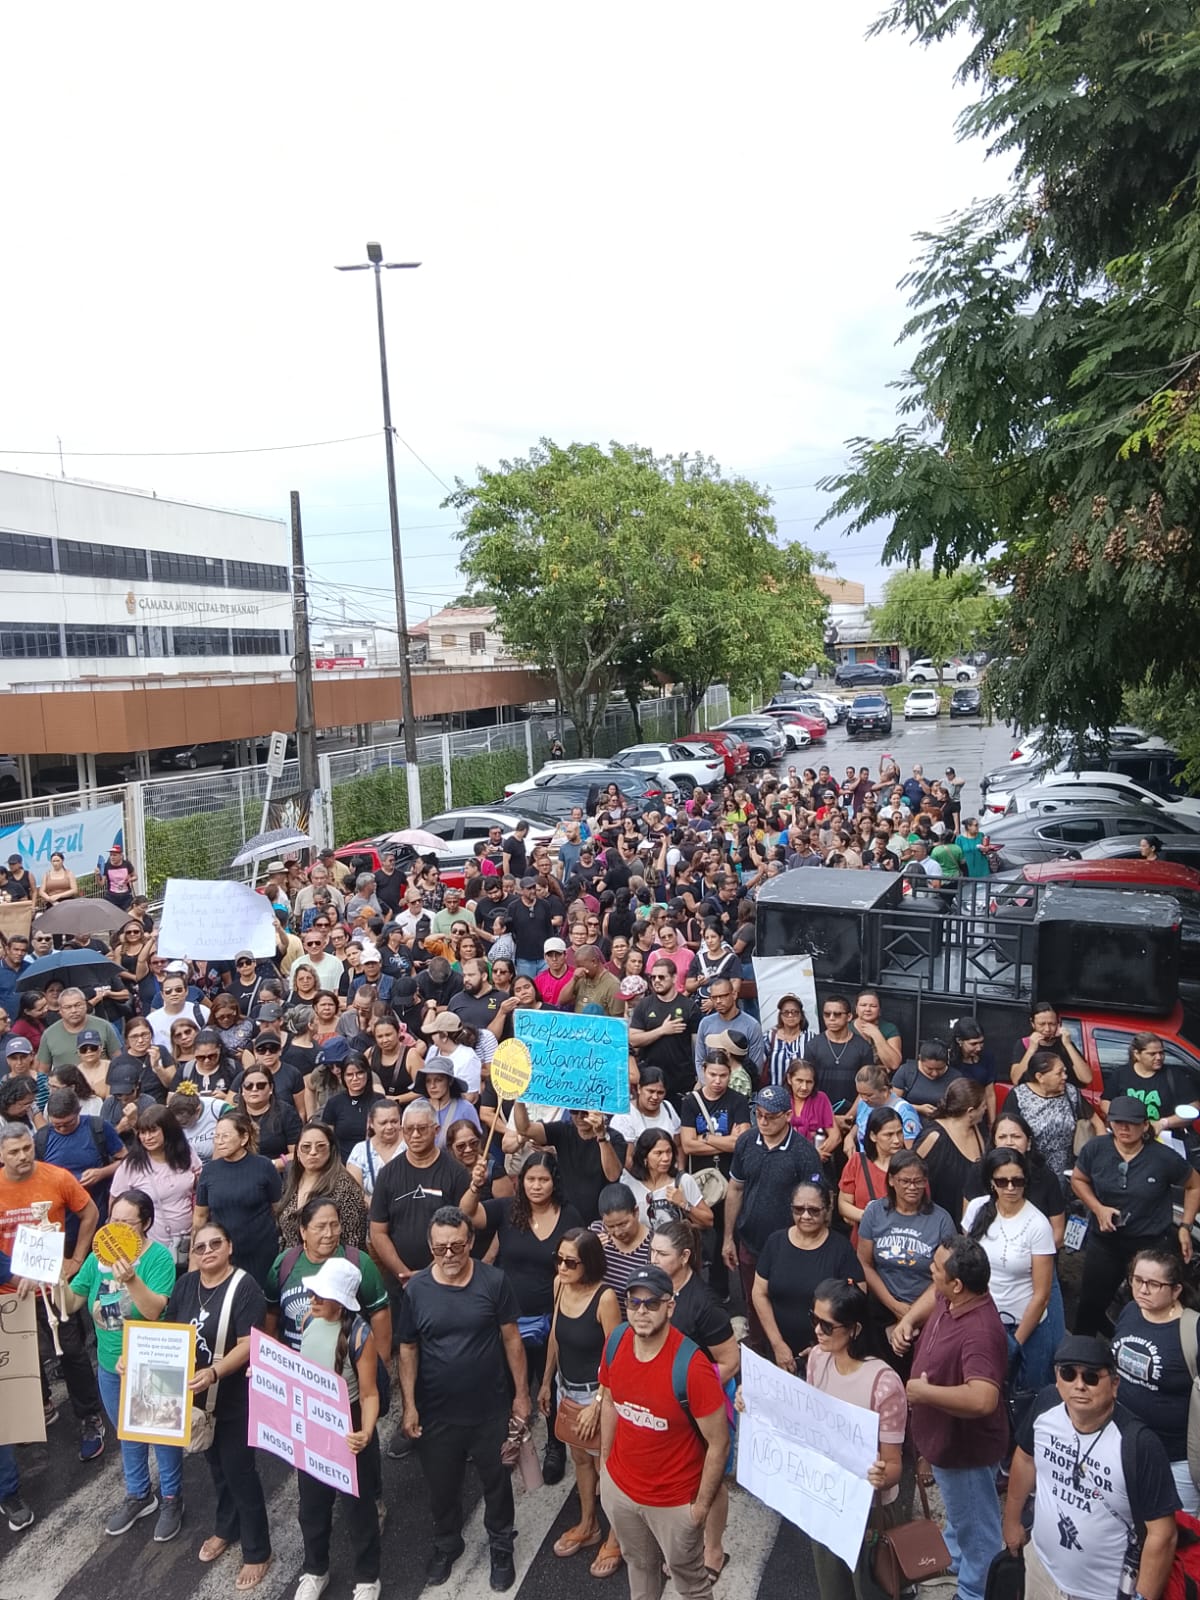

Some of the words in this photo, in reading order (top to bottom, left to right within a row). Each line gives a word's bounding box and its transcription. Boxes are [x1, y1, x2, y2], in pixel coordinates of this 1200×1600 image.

[138, 597, 175, 610] CÂMARA
[175, 600, 219, 612] MUNICIPAL
[220, 604, 230, 614] DE
[230, 604, 260, 615] MANAUS
[273, 739, 282, 756] E
[36, 823, 84, 862] Azul
[519, 1015, 613, 1046] Professores
[29, 1235, 44, 1251] DA
[876, 1236, 907, 1249] LOONEY
[907, 1238, 932, 1258] TUNES
[22, 1250, 57, 1272] MORTE
[259, 1343, 339, 1395] APOSENTADORIA
[256, 1374, 286, 1398] DIGNA
[295, 1394, 302, 1406] E
[311, 1405, 345, 1431] JUSTA
[744, 1355, 865, 1448] APOSENTADORIA
[296, 1419, 303, 1434] É
[770, 1413, 832, 1455] DIREITO
[262, 1429, 294, 1457] NOSSO
[308, 1456, 350, 1485] DIREITO
[752, 1436, 784, 1470] NÃO
[1050, 1434, 1078, 1458] Verás
[1083, 1454, 1101, 1471] ue
[1103, 1466, 1111, 1476] o
[1052, 1469, 1073, 1487] não
[1077, 1484, 1100, 1500] oge
[1052, 1482, 1058, 1497] à
[1060, 1488, 1093, 1514] LUTA
